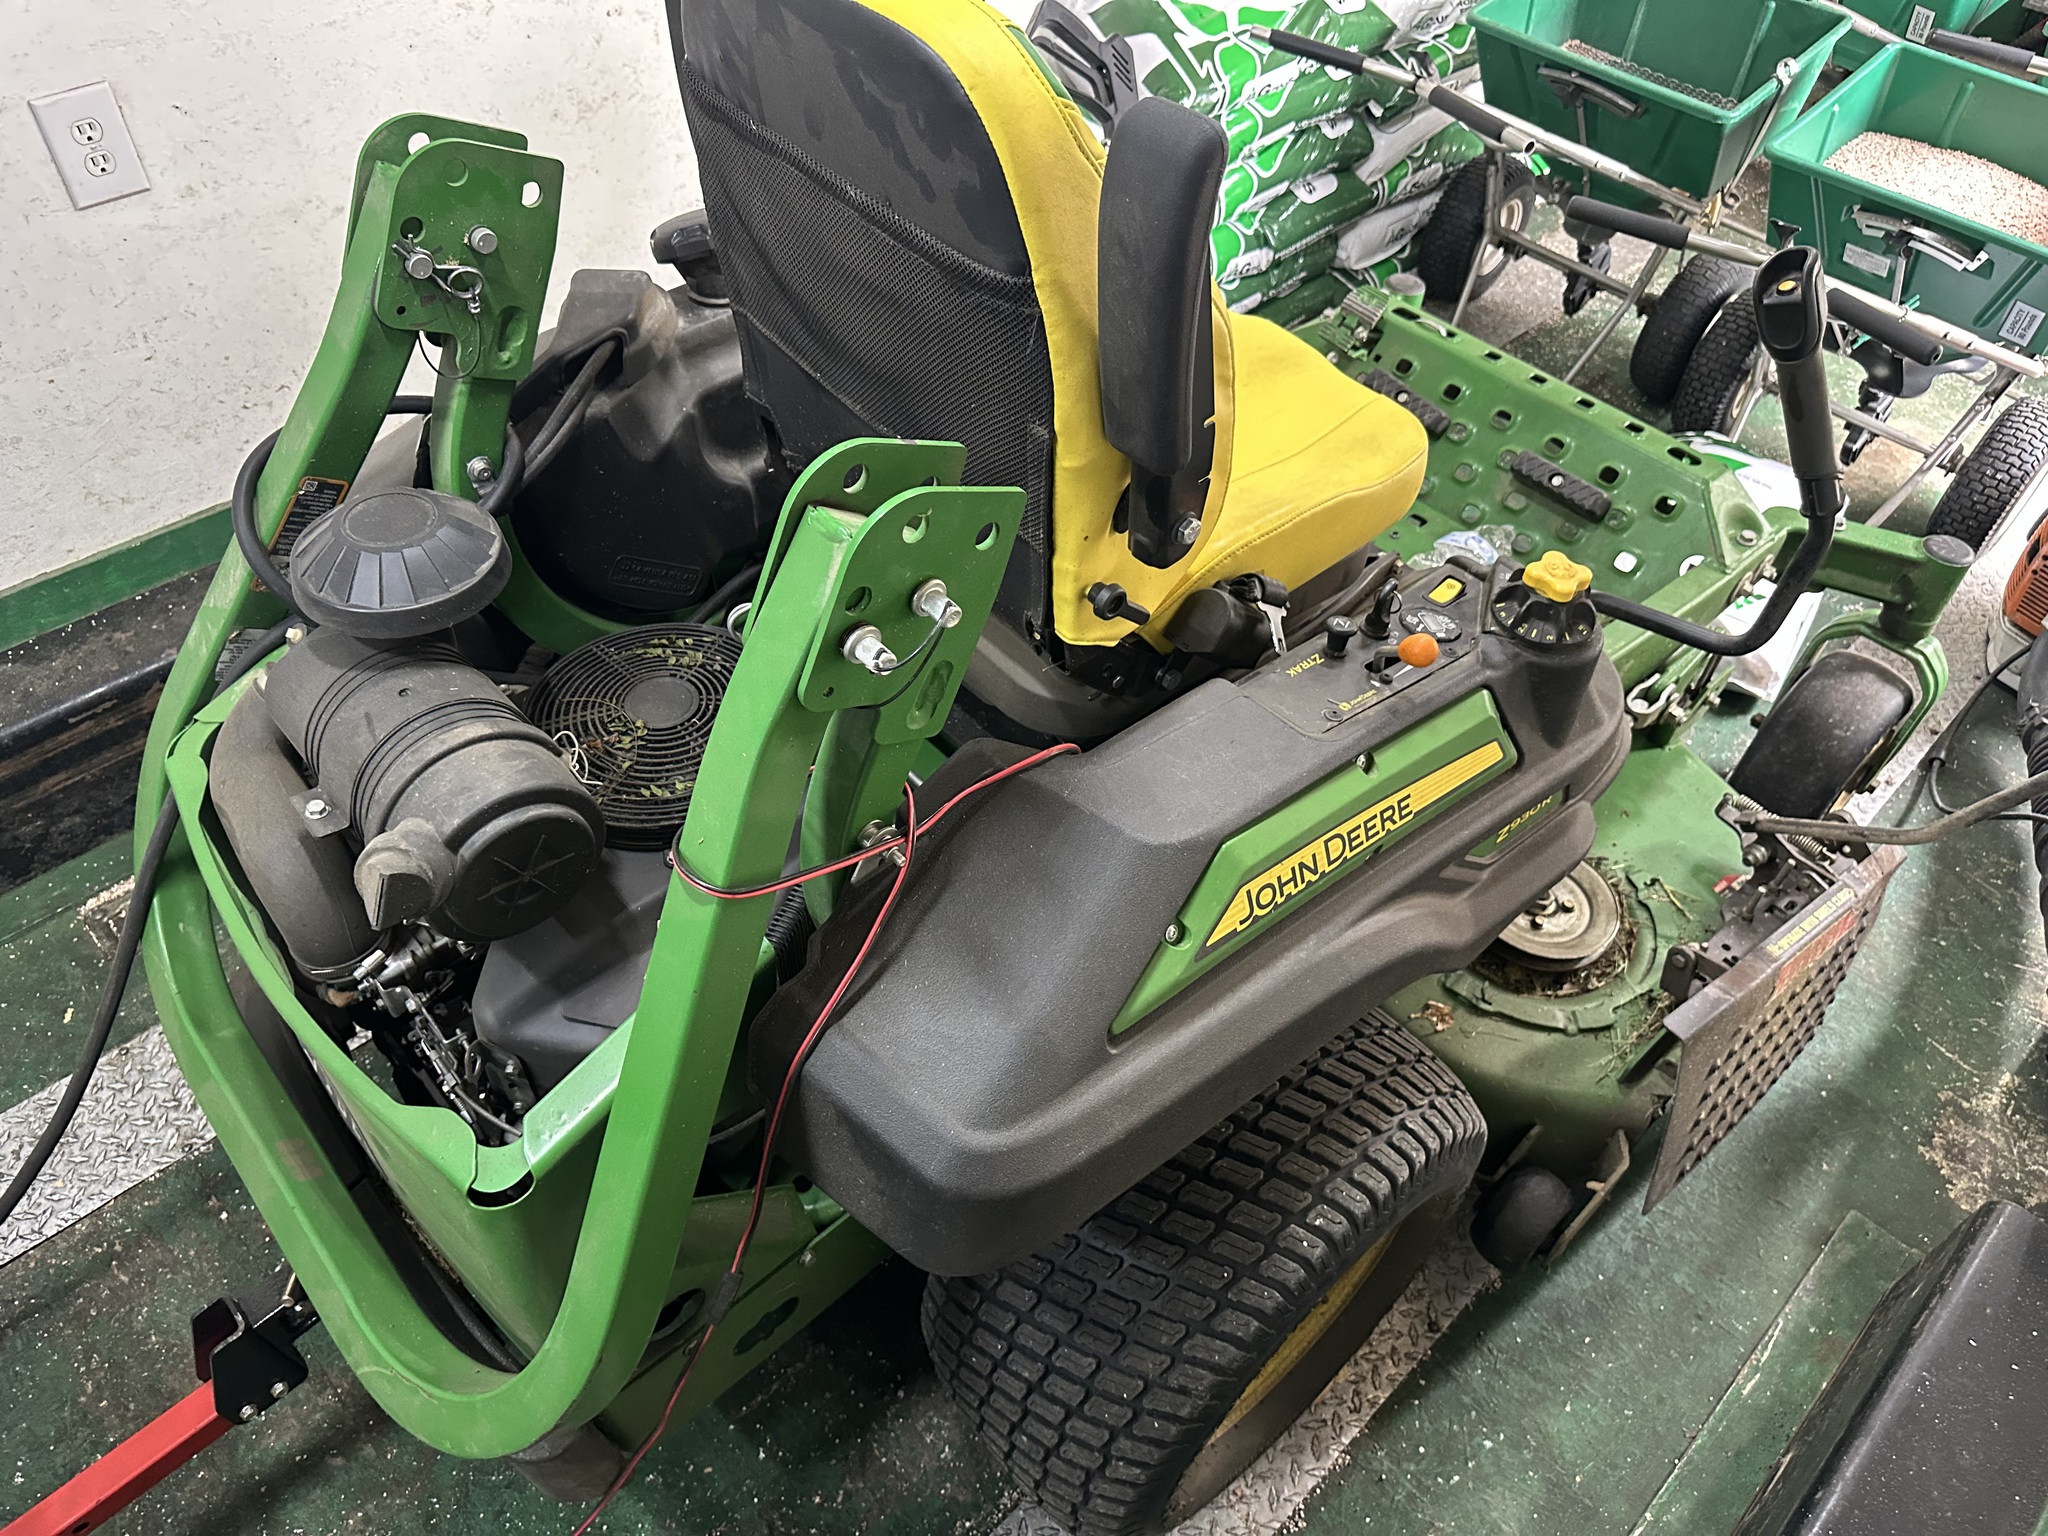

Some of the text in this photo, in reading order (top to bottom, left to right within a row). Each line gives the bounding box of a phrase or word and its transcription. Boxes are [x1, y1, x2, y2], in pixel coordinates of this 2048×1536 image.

[1910, 11, 1921, 36] CAPACITY
[2006, 308, 2026, 335] CAPACITY
[2021, 314, 2037, 334] Pounds
[1285, 653, 1325, 678] ZTRAK
[1239, 794, 1413, 925] JOHN DEERE
